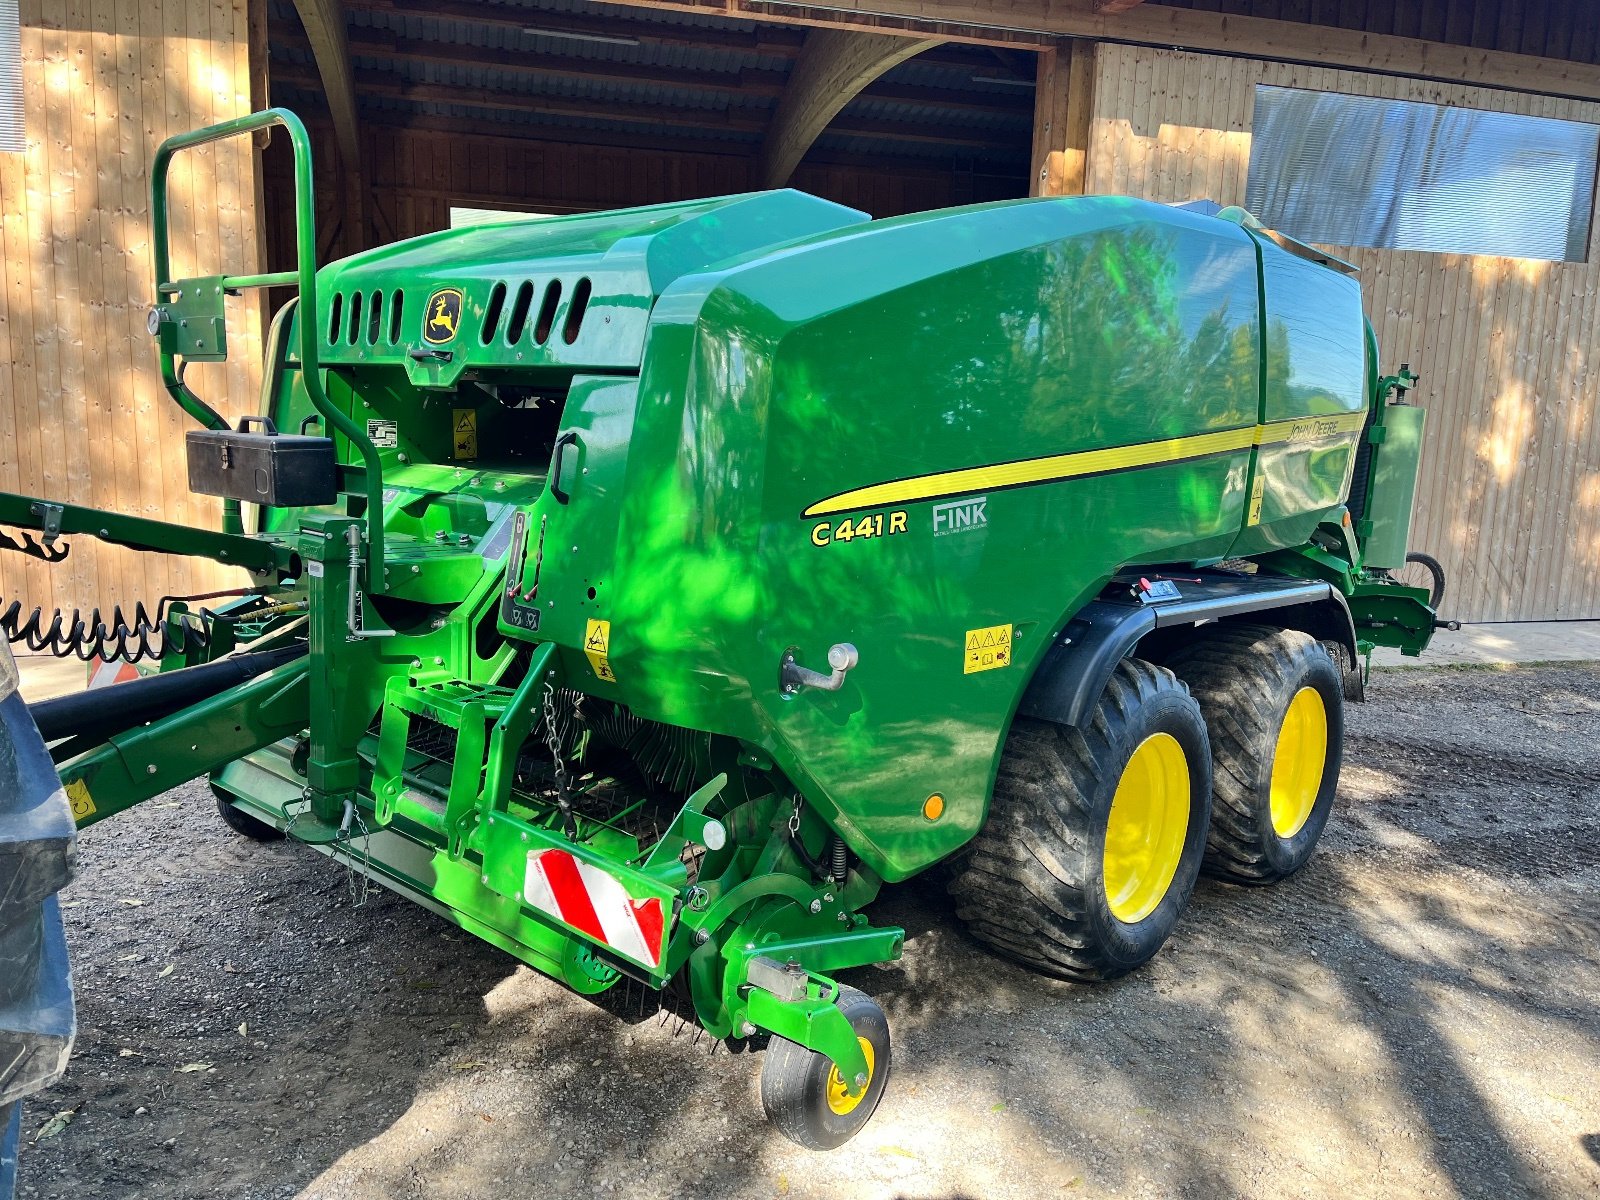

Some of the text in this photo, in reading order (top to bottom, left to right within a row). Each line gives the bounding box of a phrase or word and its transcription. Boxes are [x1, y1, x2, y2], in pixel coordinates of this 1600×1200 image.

[1286, 420, 1339, 440] JOHN DEERE
[811, 522, 831, 547] C
[834, 513, 884, 543] 441
[889, 510, 909, 534] R
[933, 497, 987, 531] FINK
